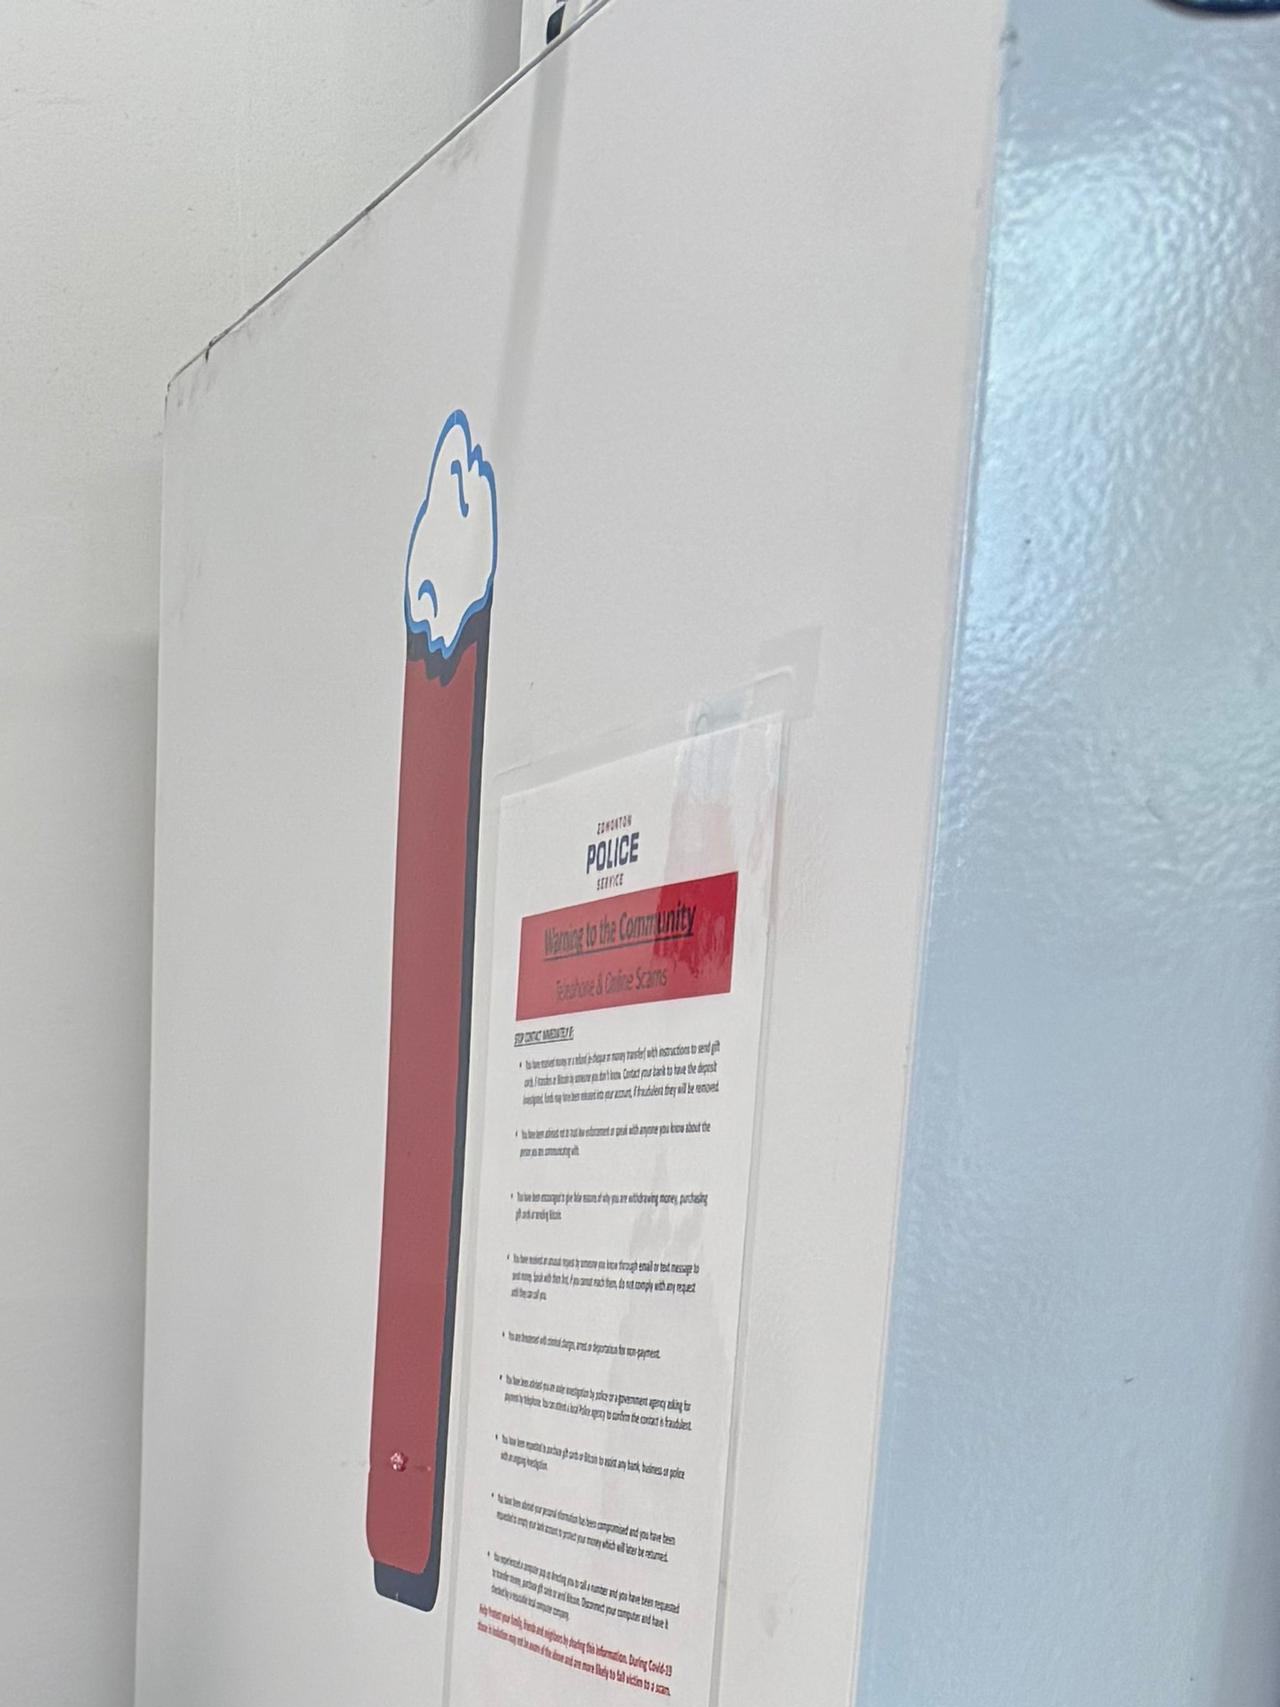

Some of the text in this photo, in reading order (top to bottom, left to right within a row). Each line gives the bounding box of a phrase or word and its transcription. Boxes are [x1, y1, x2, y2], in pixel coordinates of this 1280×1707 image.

[587, 832, 639, 874] POLICE
[544, 901, 697, 955] Warning to the Community
